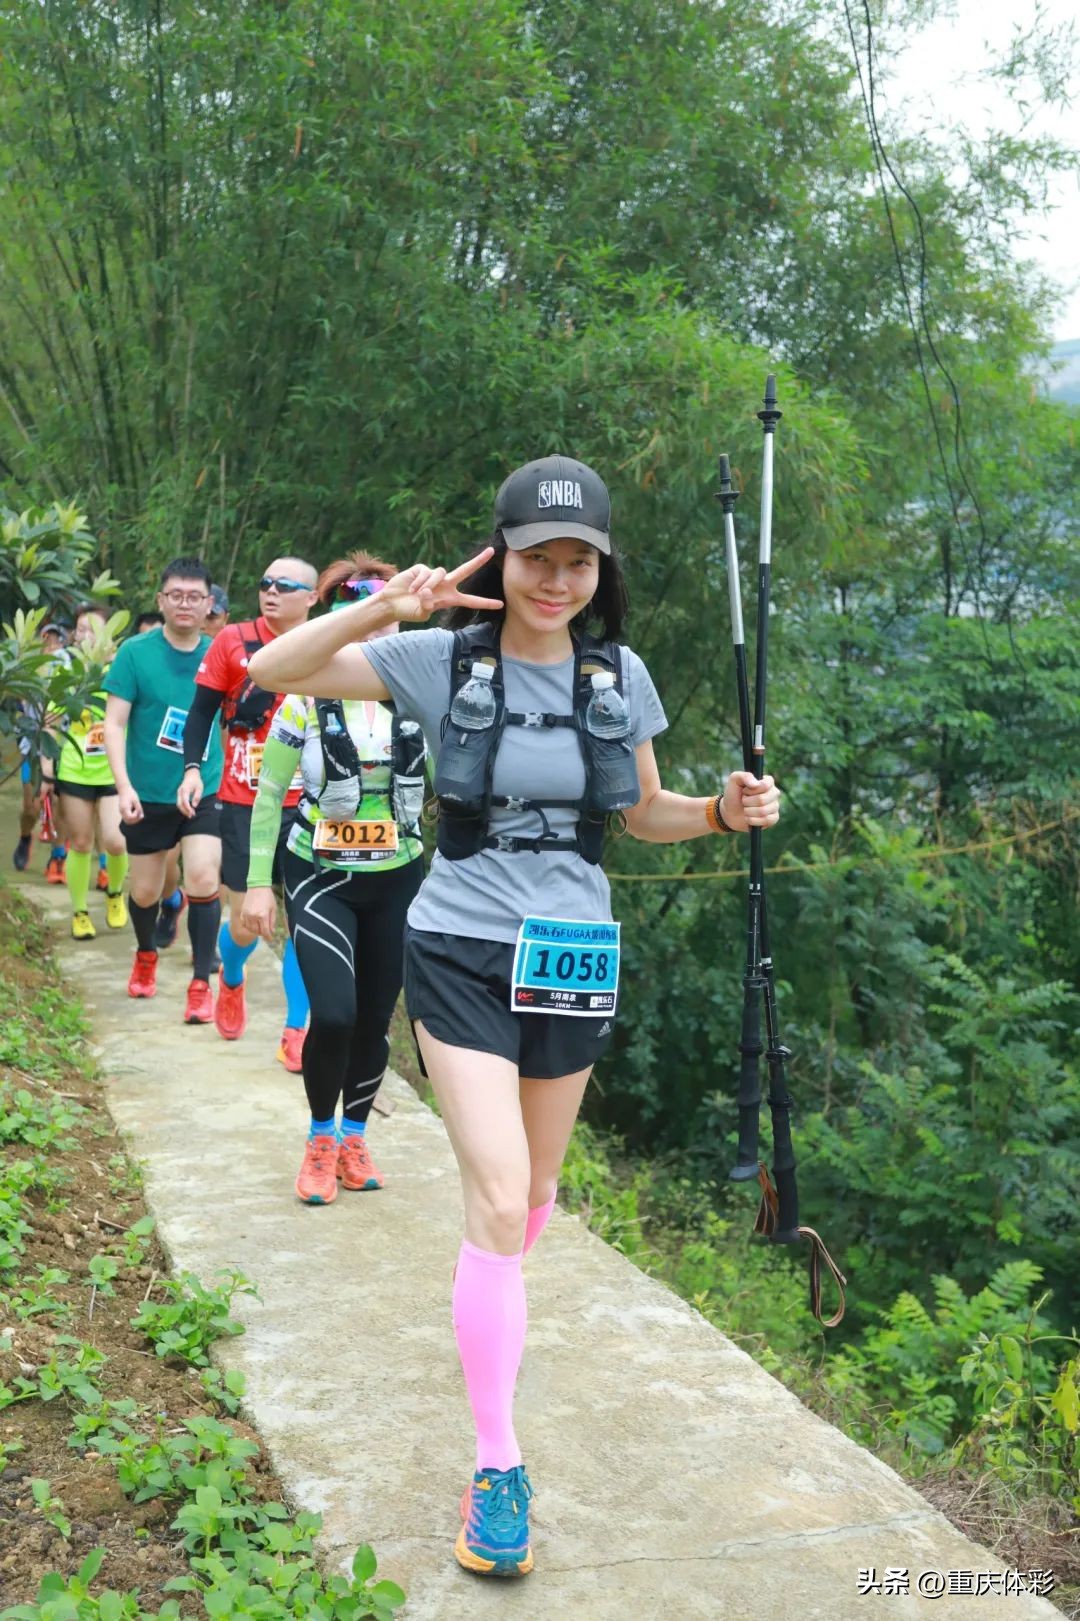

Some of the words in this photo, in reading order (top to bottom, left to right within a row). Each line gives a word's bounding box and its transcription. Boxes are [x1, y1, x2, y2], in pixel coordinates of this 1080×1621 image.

[552, 480, 583, 509] NBA
[327, 824, 387, 844] 2012
[533, 950, 608, 981] 1058
